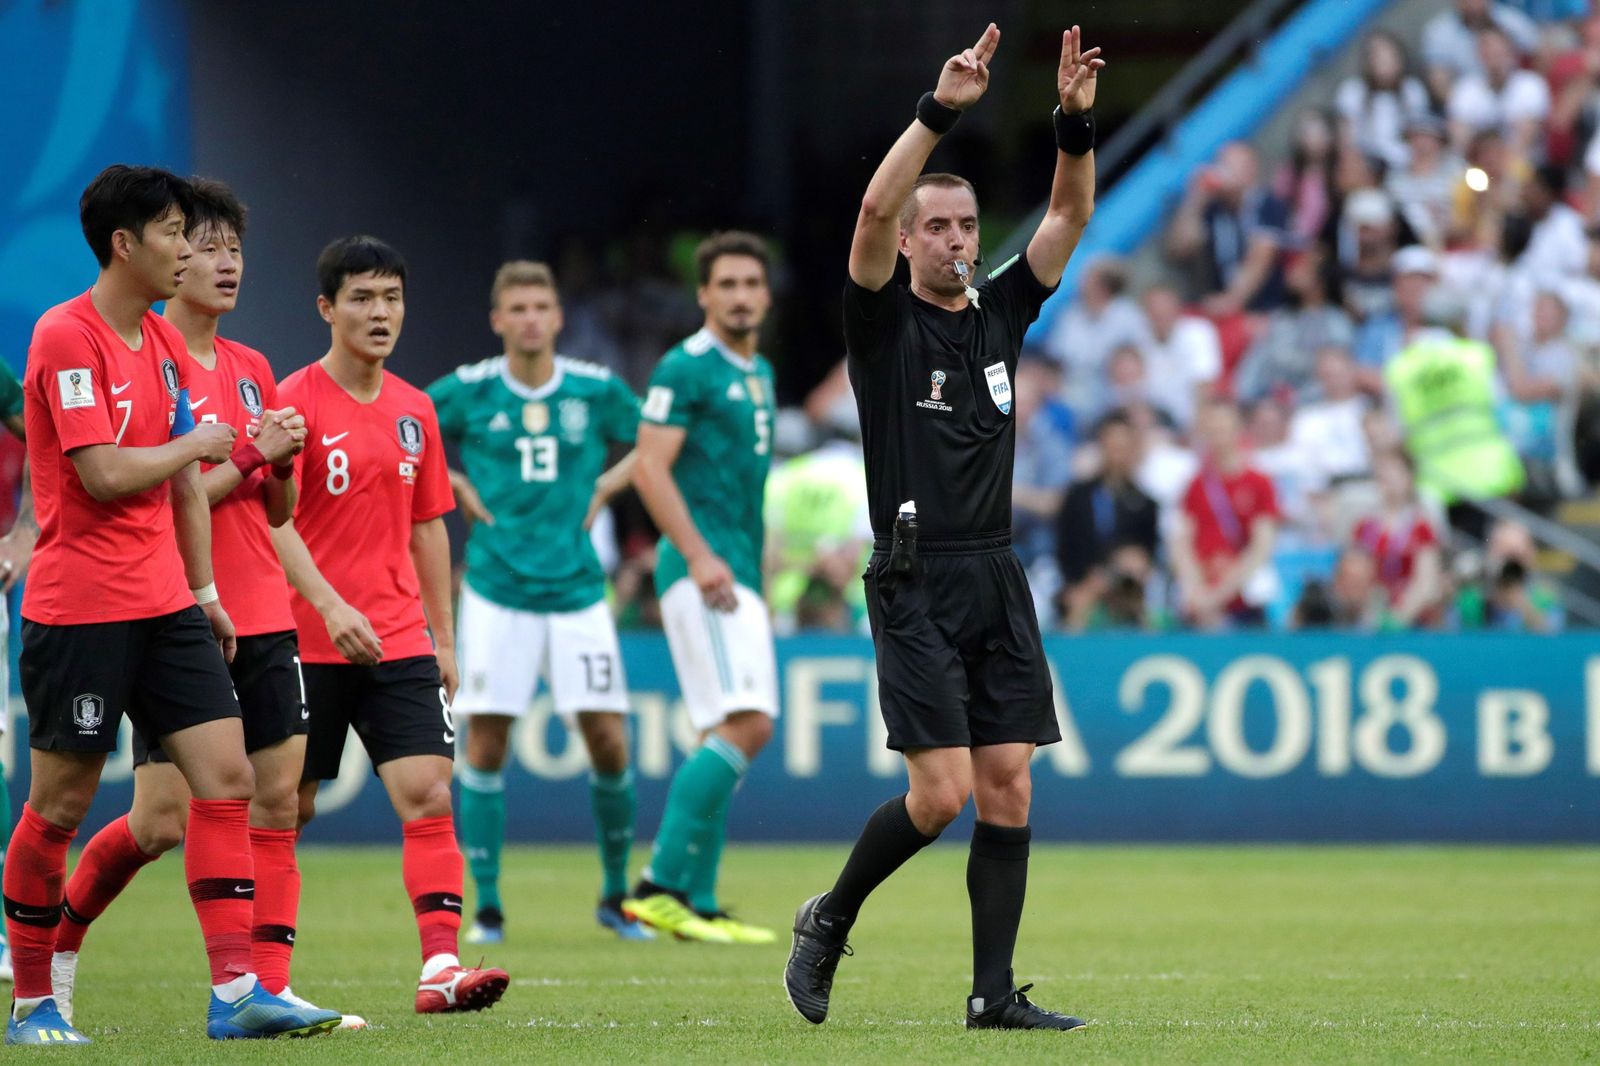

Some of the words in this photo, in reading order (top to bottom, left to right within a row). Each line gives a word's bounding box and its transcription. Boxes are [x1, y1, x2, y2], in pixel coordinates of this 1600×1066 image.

[916, 401, 938, 409] RUSSIA
[993, 382, 1009, 396] FIFA
[116, 400, 132, 445] 7
[326, 449, 350, 496] 8
[515, 436, 558, 482] 13
[580, 653, 611, 691] 13
[1115, 654, 1447, 779] 2018
